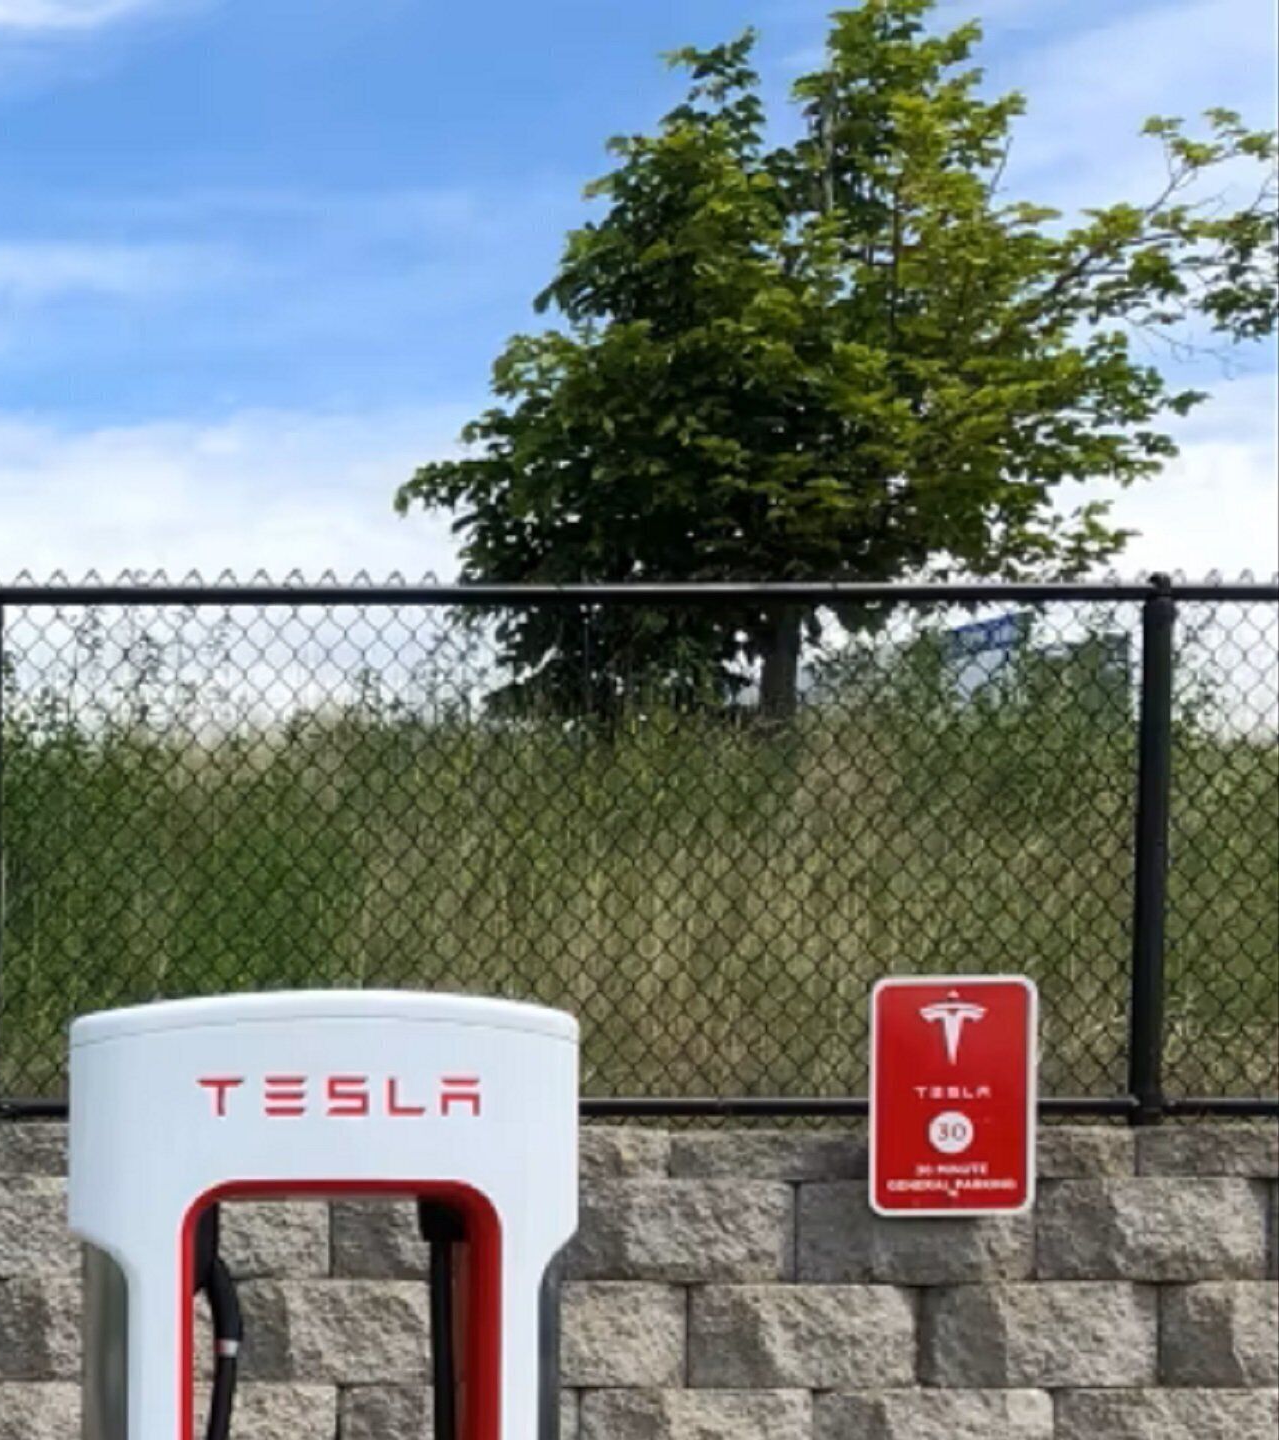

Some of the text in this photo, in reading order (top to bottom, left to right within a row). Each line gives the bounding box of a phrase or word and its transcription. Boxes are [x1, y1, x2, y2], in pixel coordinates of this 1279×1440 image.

[195, 1075, 481, 1117] TESLA
[913, 1085, 992, 1099] TESLA
[935, 1122, 967, 1142] 30
